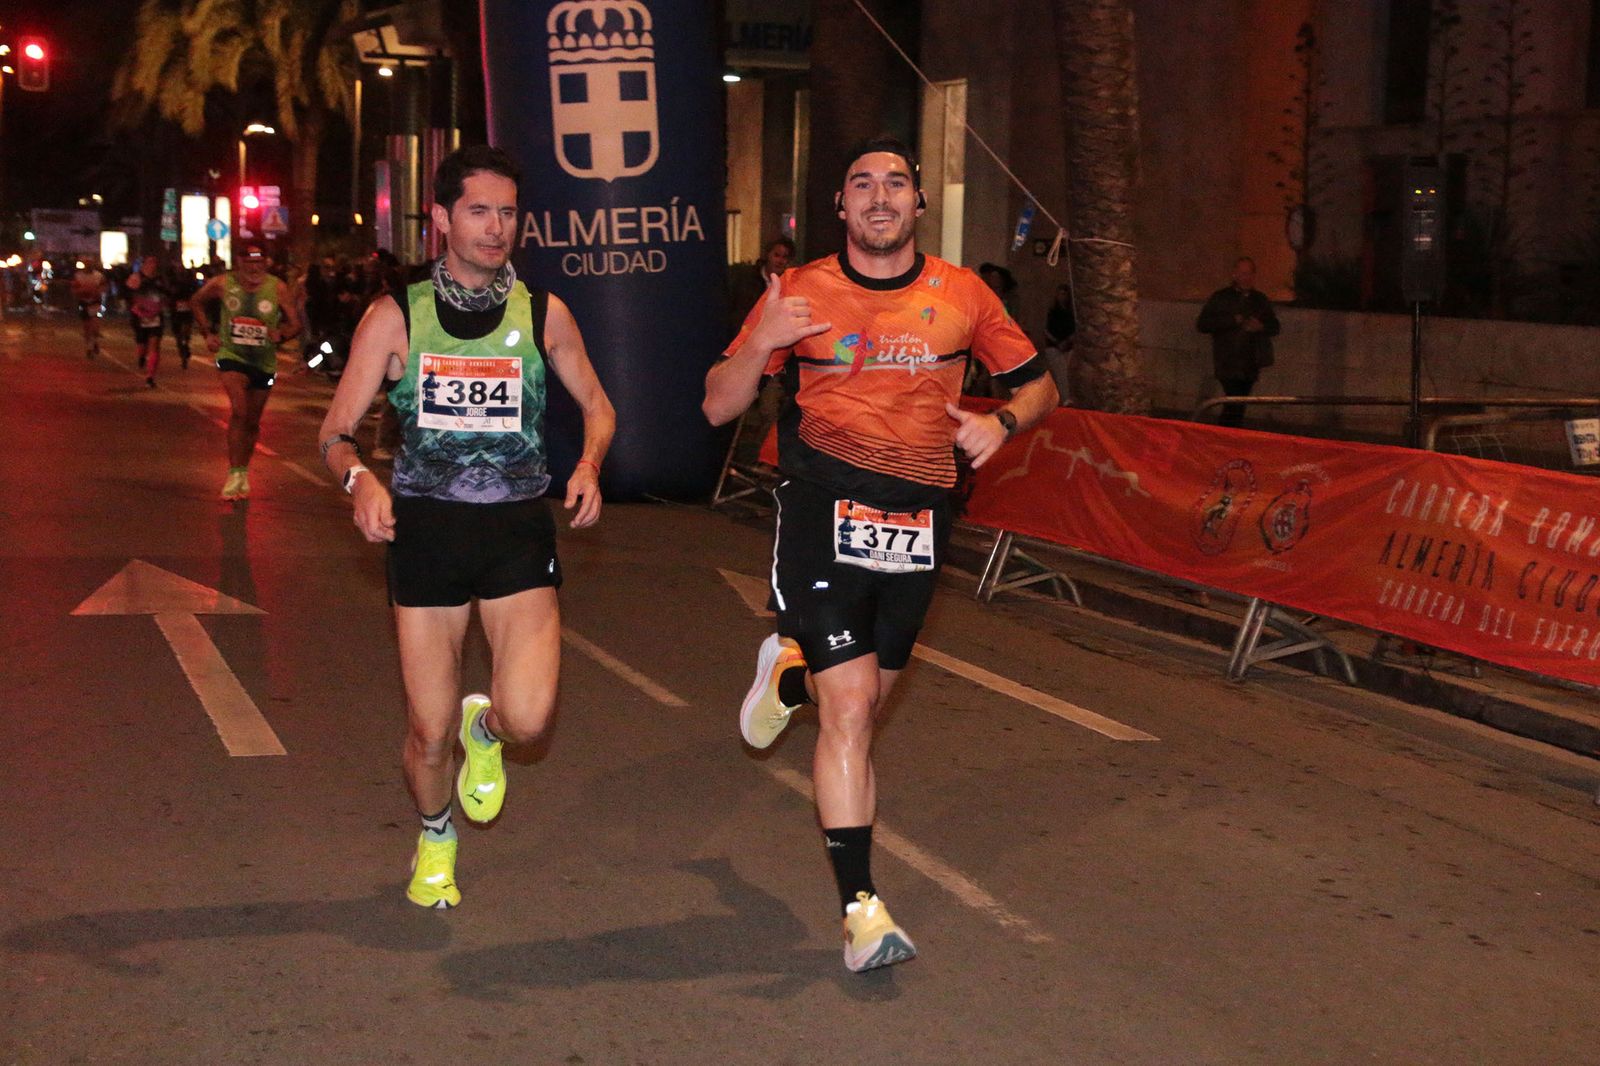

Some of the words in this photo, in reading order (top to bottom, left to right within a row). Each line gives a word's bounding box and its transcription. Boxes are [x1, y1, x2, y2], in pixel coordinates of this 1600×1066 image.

[724, 18, 814, 49] LMERÍA
[520, 196, 705, 249] ALMERÍA
[562, 250, 668, 277] CIUDAD
[880, 332, 922, 344] triatlón
[446, 380, 509, 405] 384
[466, 407, 487, 417] JORGE
[1385, 478, 1509, 537] CARRERA
[863, 525, 919, 552] 377
[869, 550, 884, 562] DANI
[886, 551, 913, 564] SEGURA
[1518, 560, 1600, 616] CIUD
[1477, 604, 1516, 639] DEL
